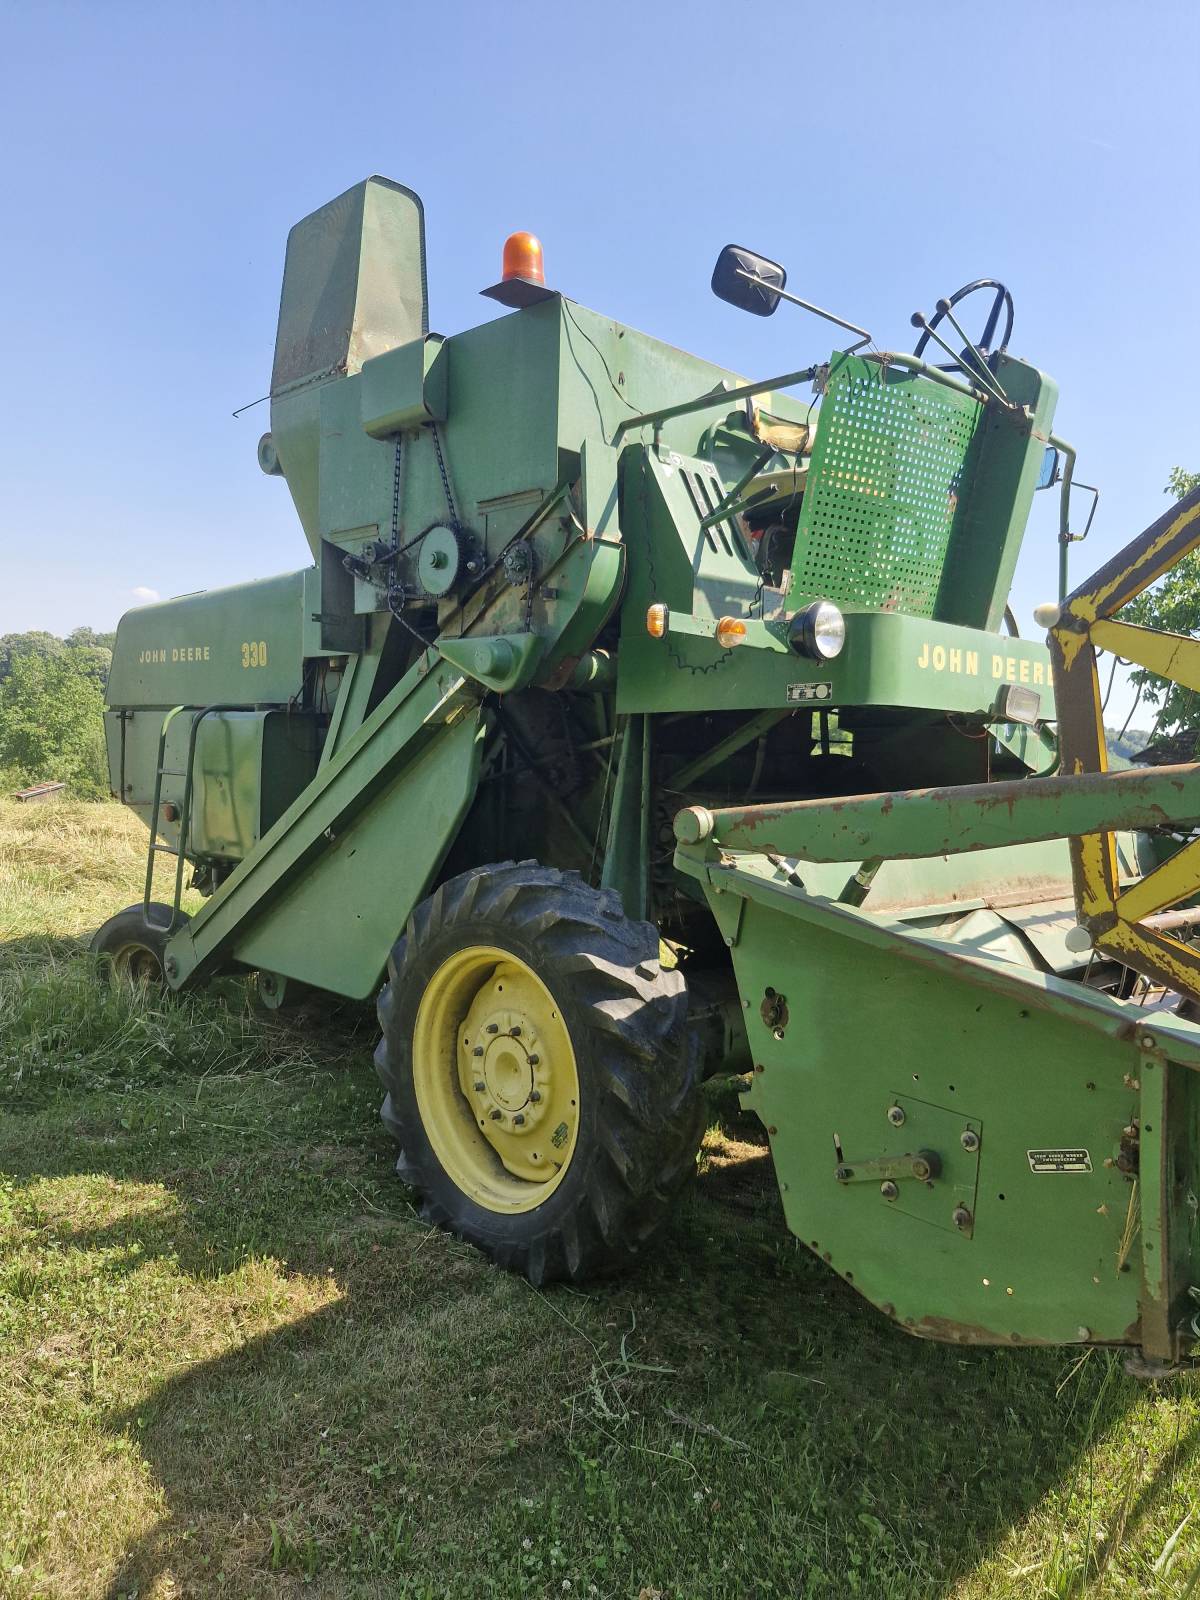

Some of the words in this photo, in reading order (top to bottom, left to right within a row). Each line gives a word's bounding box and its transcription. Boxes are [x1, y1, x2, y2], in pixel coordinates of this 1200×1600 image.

[139, 649, 166, 663] JOHN
[172, 646, 210, 662] DEERE
[241, 641, 267, 668] 330
[918, 643, 978, 676] JOHN
